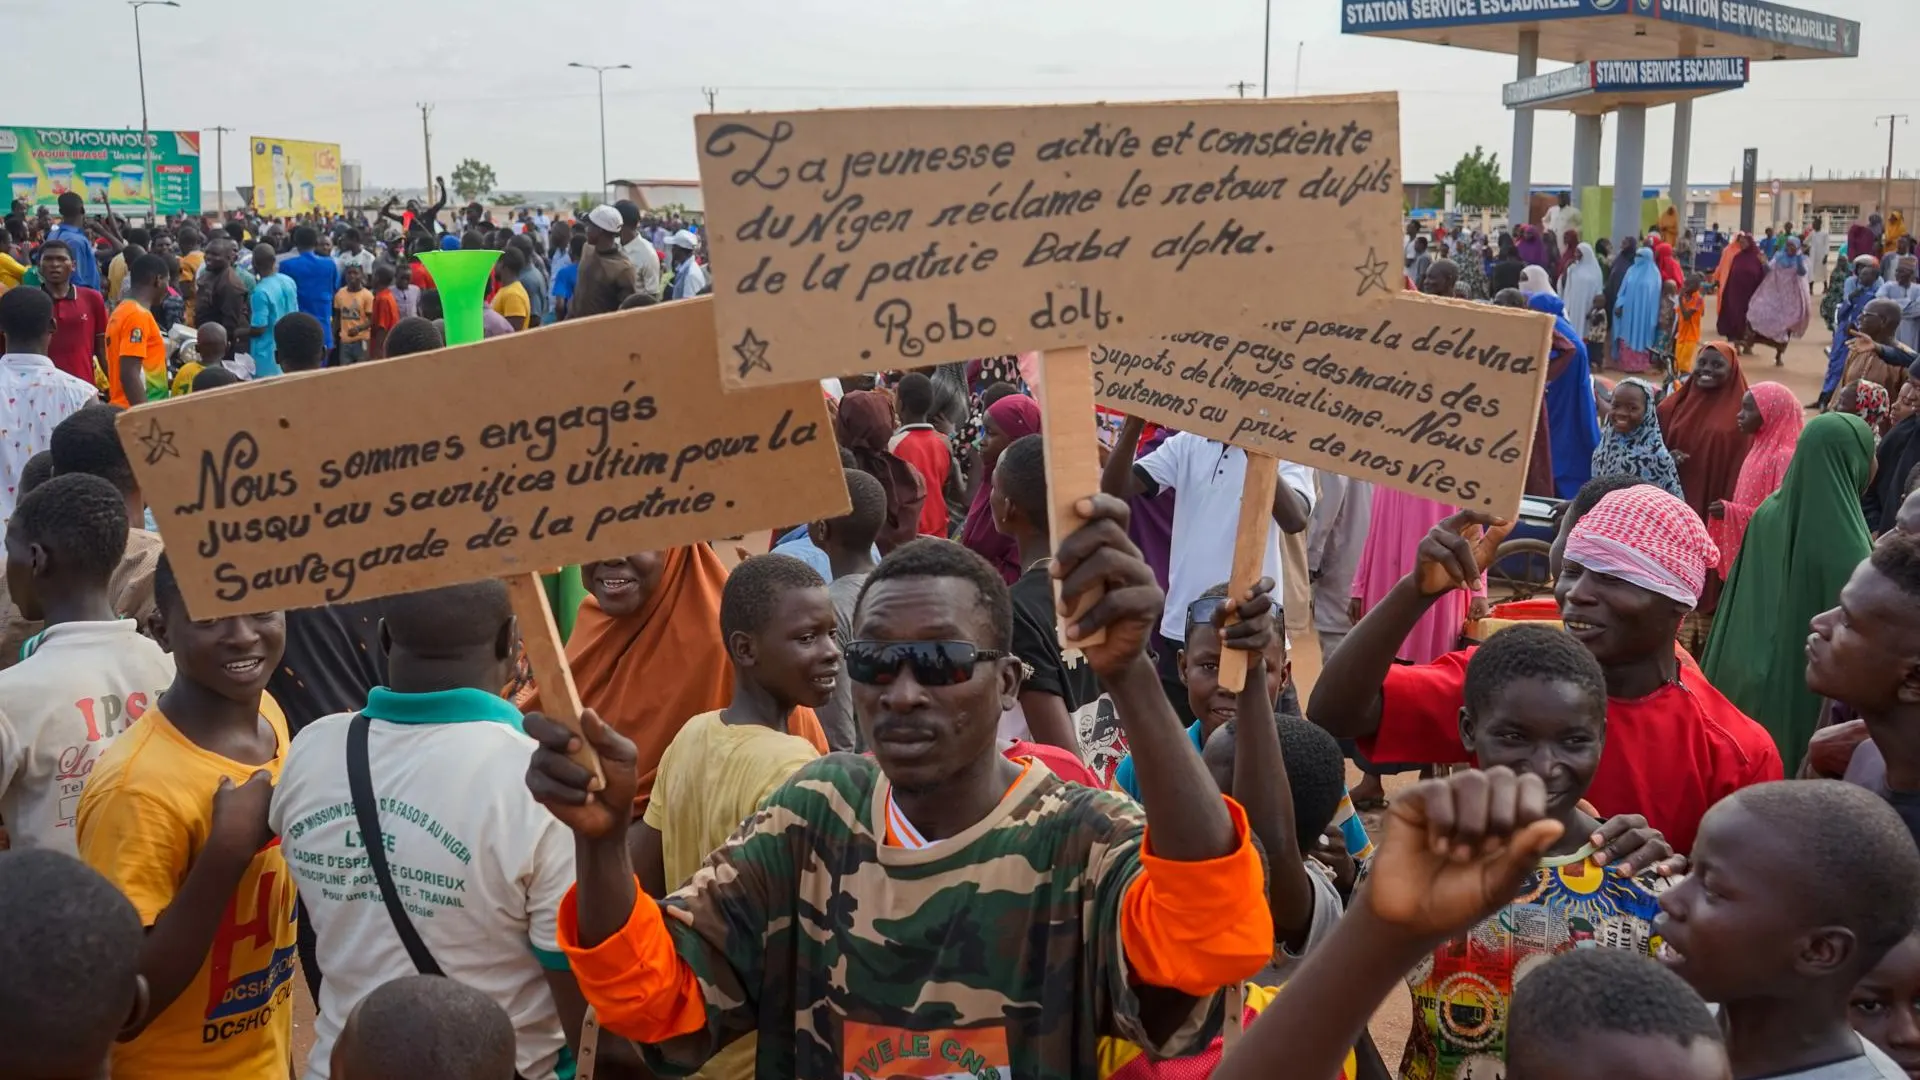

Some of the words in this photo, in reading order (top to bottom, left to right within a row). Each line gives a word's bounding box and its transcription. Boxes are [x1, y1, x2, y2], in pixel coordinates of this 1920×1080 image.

[1346, 1, 1409, 25] STATION
[1411, 0, 1478, 19] SERVICE
[1662, 0, 1719, 19] STATION
[1721, 4, 1772, 32] SERVICE
[1775, 13, 1837, 42] ESCADRILLE
[1596, 61, 1638, 85] STATION
[1639, 60, 1681, 84] SERVICE
[1683, 58, 1745, 82] ESCADRILLE
[705, 120, 827, 190] La
[822, 140, 1016, 202] jeunesse
[1036, 121, 1141, 162] active
[1151, 120, 1196, 158] et
[736, 204, 795, 243] du
[927, 178, 1103, 229] réclame
[1116, 168, 1152, 209] le
[1160, 164, 1290, 207] retour
[1299, 166, 1343, 201] du
[1338, 157, 1393, 207] fils
[736, 255, 788, 295] de
[802, 252, 851, 292] la
[854, 240, 999, 303] patrie
[1022, 228, 1131, 268] Baba
[1295, 318, 1367, 351] pour
[1372, 317, 1404, 352] la
[1224, 340, 1296, 376] pays
[1303, 350, 1348, 387] des
[1346, 368, 1434, 407] mains
[1439, 383, 1501, 419] des
[174, 430, 298, 517] Nous
[318, 433, 466, 489] sommes
[479, 380, 658, 462] engagés
[383, 463, 556, 517] sacrifice
[565, 440, 670, 487] ultim
[670, 432, 760, 484] pour
[768, 408, 818, 451] la
[1199, 403, 1229, 424] au
[1231, 413, 1299, 447] prix
[1308, 432, 1346, 459] de
[1349, 447, 1405, 478] nos
[1488, 428, 1522, 464] le
[465, 517, 520, 551] de
[528, 505, 574, 541] la
[585, 483, 736, 542] patrie.
[426, 820, 443, 838] AU
[440, 830, 472, 866] NIGER
[292, 847, 325, 866] CADRE
[400, 866, 466, 893] GLORIEUX
[345, 890, 368, 902] une
[418, 888, 465, 909] TRAVAIL
[899, 1035, 930, 1058] LE
